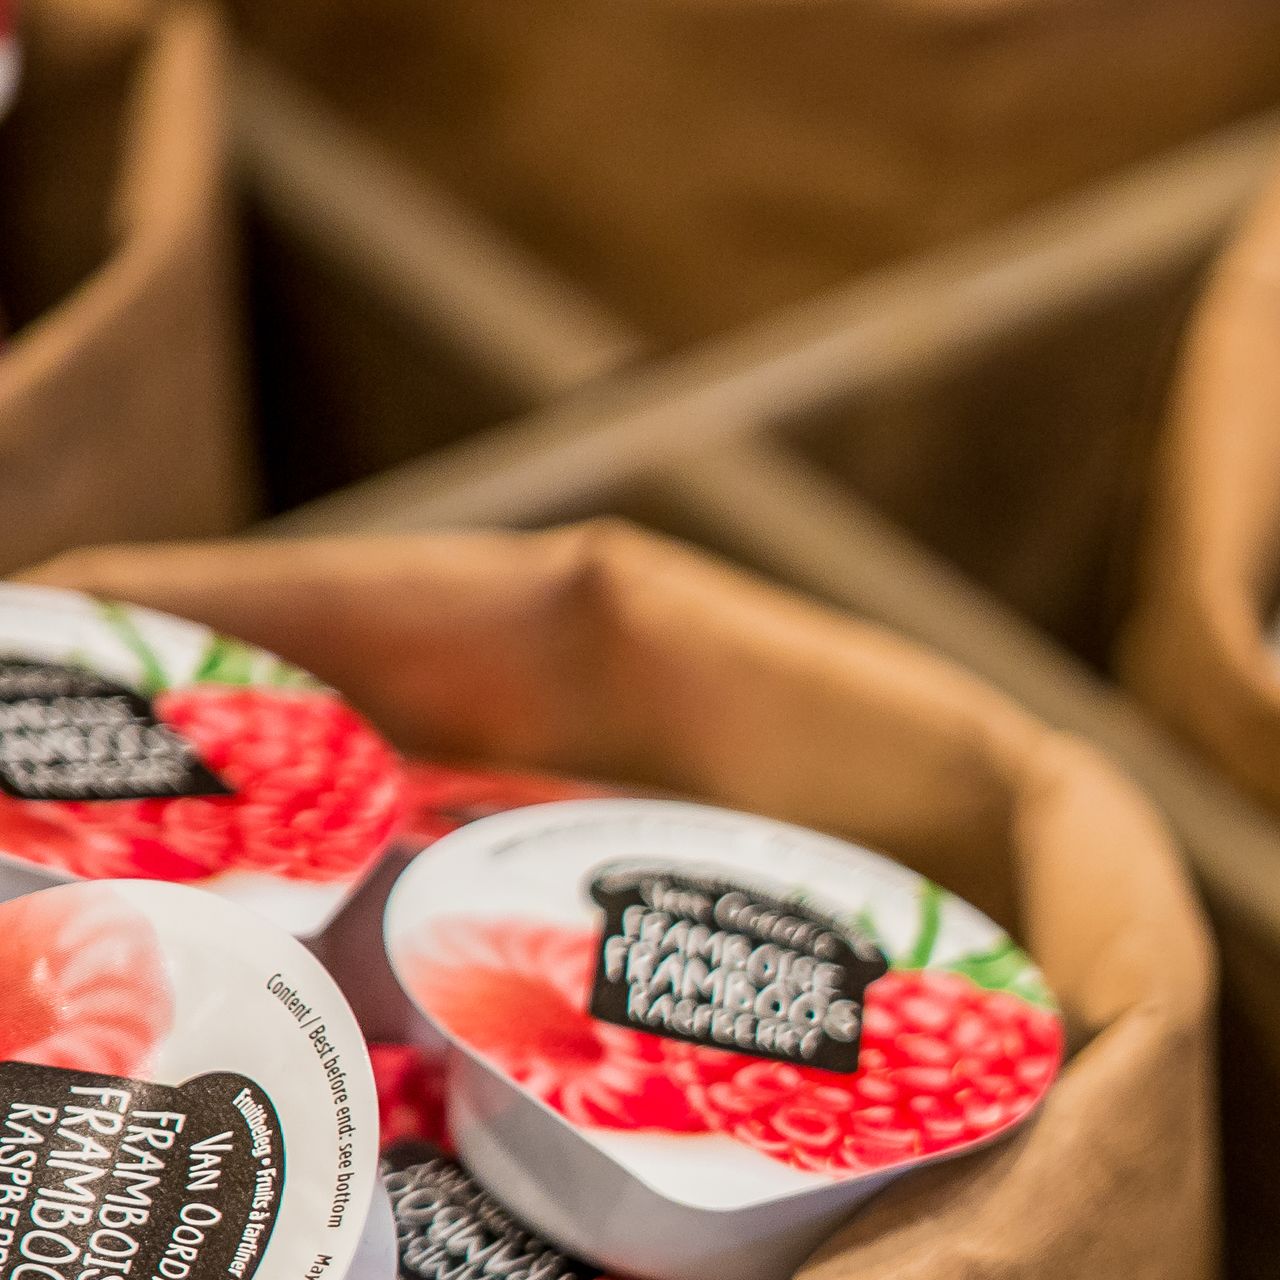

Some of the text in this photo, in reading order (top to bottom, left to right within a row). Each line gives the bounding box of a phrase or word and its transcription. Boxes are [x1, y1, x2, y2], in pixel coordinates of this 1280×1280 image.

[266, 973, 312, 1023] Content
[309, 1025, 335, 1054] Best
[324, 1055, 347, 1104] before
[336, 1106, 356, 1141] end:
[186, 1130, 234, 1191] VAN
[339, 1141, 353, 1169] see
[251, 1167, 277, 1210] Fruits
[328, 1172, 355, 1228] bottom
[227, 1222, 265, 1279] tartiner
